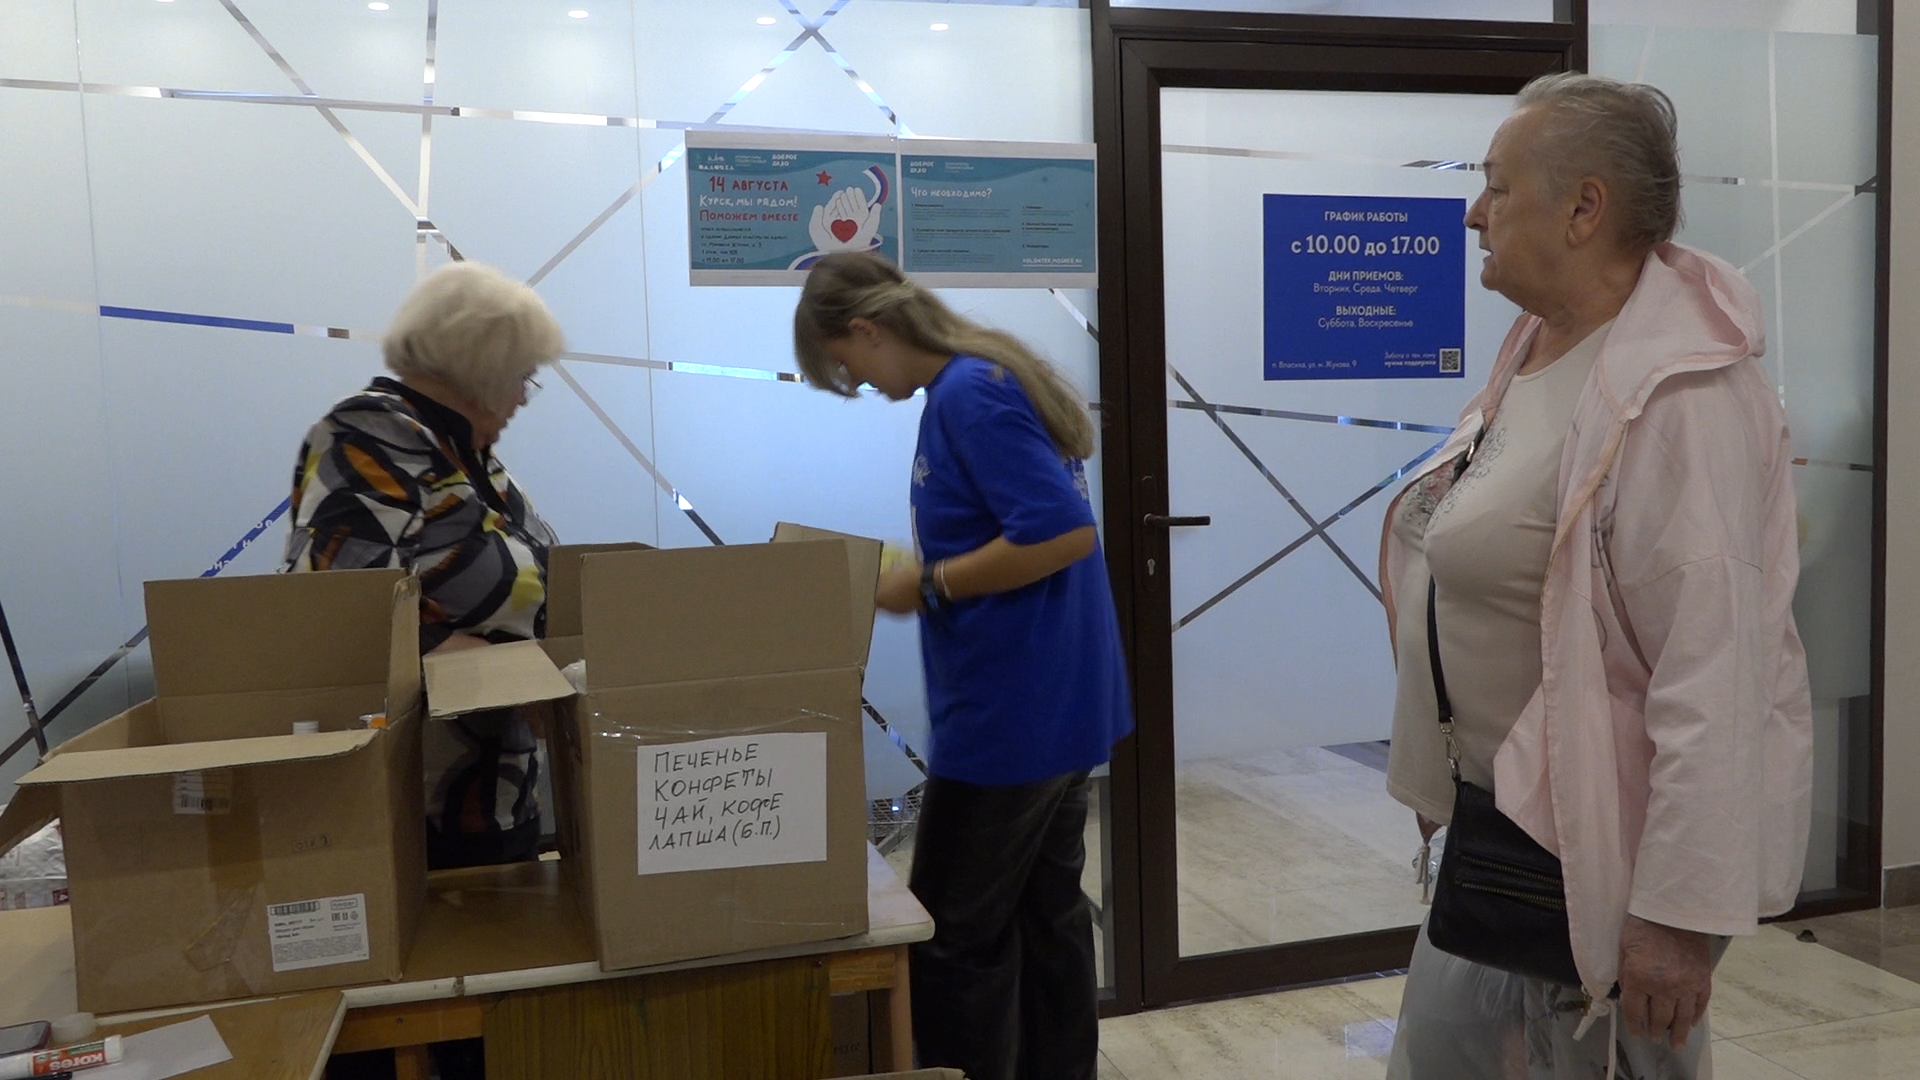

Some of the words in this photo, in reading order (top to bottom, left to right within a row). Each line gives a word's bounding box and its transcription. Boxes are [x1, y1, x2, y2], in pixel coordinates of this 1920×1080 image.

[709, 176, 725, 192] 14
[732, 180, 788, 191] АВГУСТА
[1324, 211, 1364, 222] ГРАФИК
[1367, 212, 1408, 222] РАБОТЫ
[1291, 241, 1301, 253] с
[1306, 235, 1360, 253] 10.00
[1364, 242, 1386, 256] до
[1391, 237, 1440, 254] 17.00
[1328, 271, 1350, 281] ДНИ
[1353, 271, 1403, 281] ПРИЕМОВ:
[1384, 284, 1418, 295] Четверг
[1336, 306, 1396, 316] ВЫХОДНЫЕ:
[1318, 317, 1356, 330] Суббота,
[1359, 318, 1414, 329] Воскресенье
[654, 743, 759, 773] ПЕЧЕНЬЕ
[654, 768, 773, 801] КОНФЕТЫ
[654, 798, 714, 830] ЧАЙ,
[721, 793, 783, 820] КОФЕ
